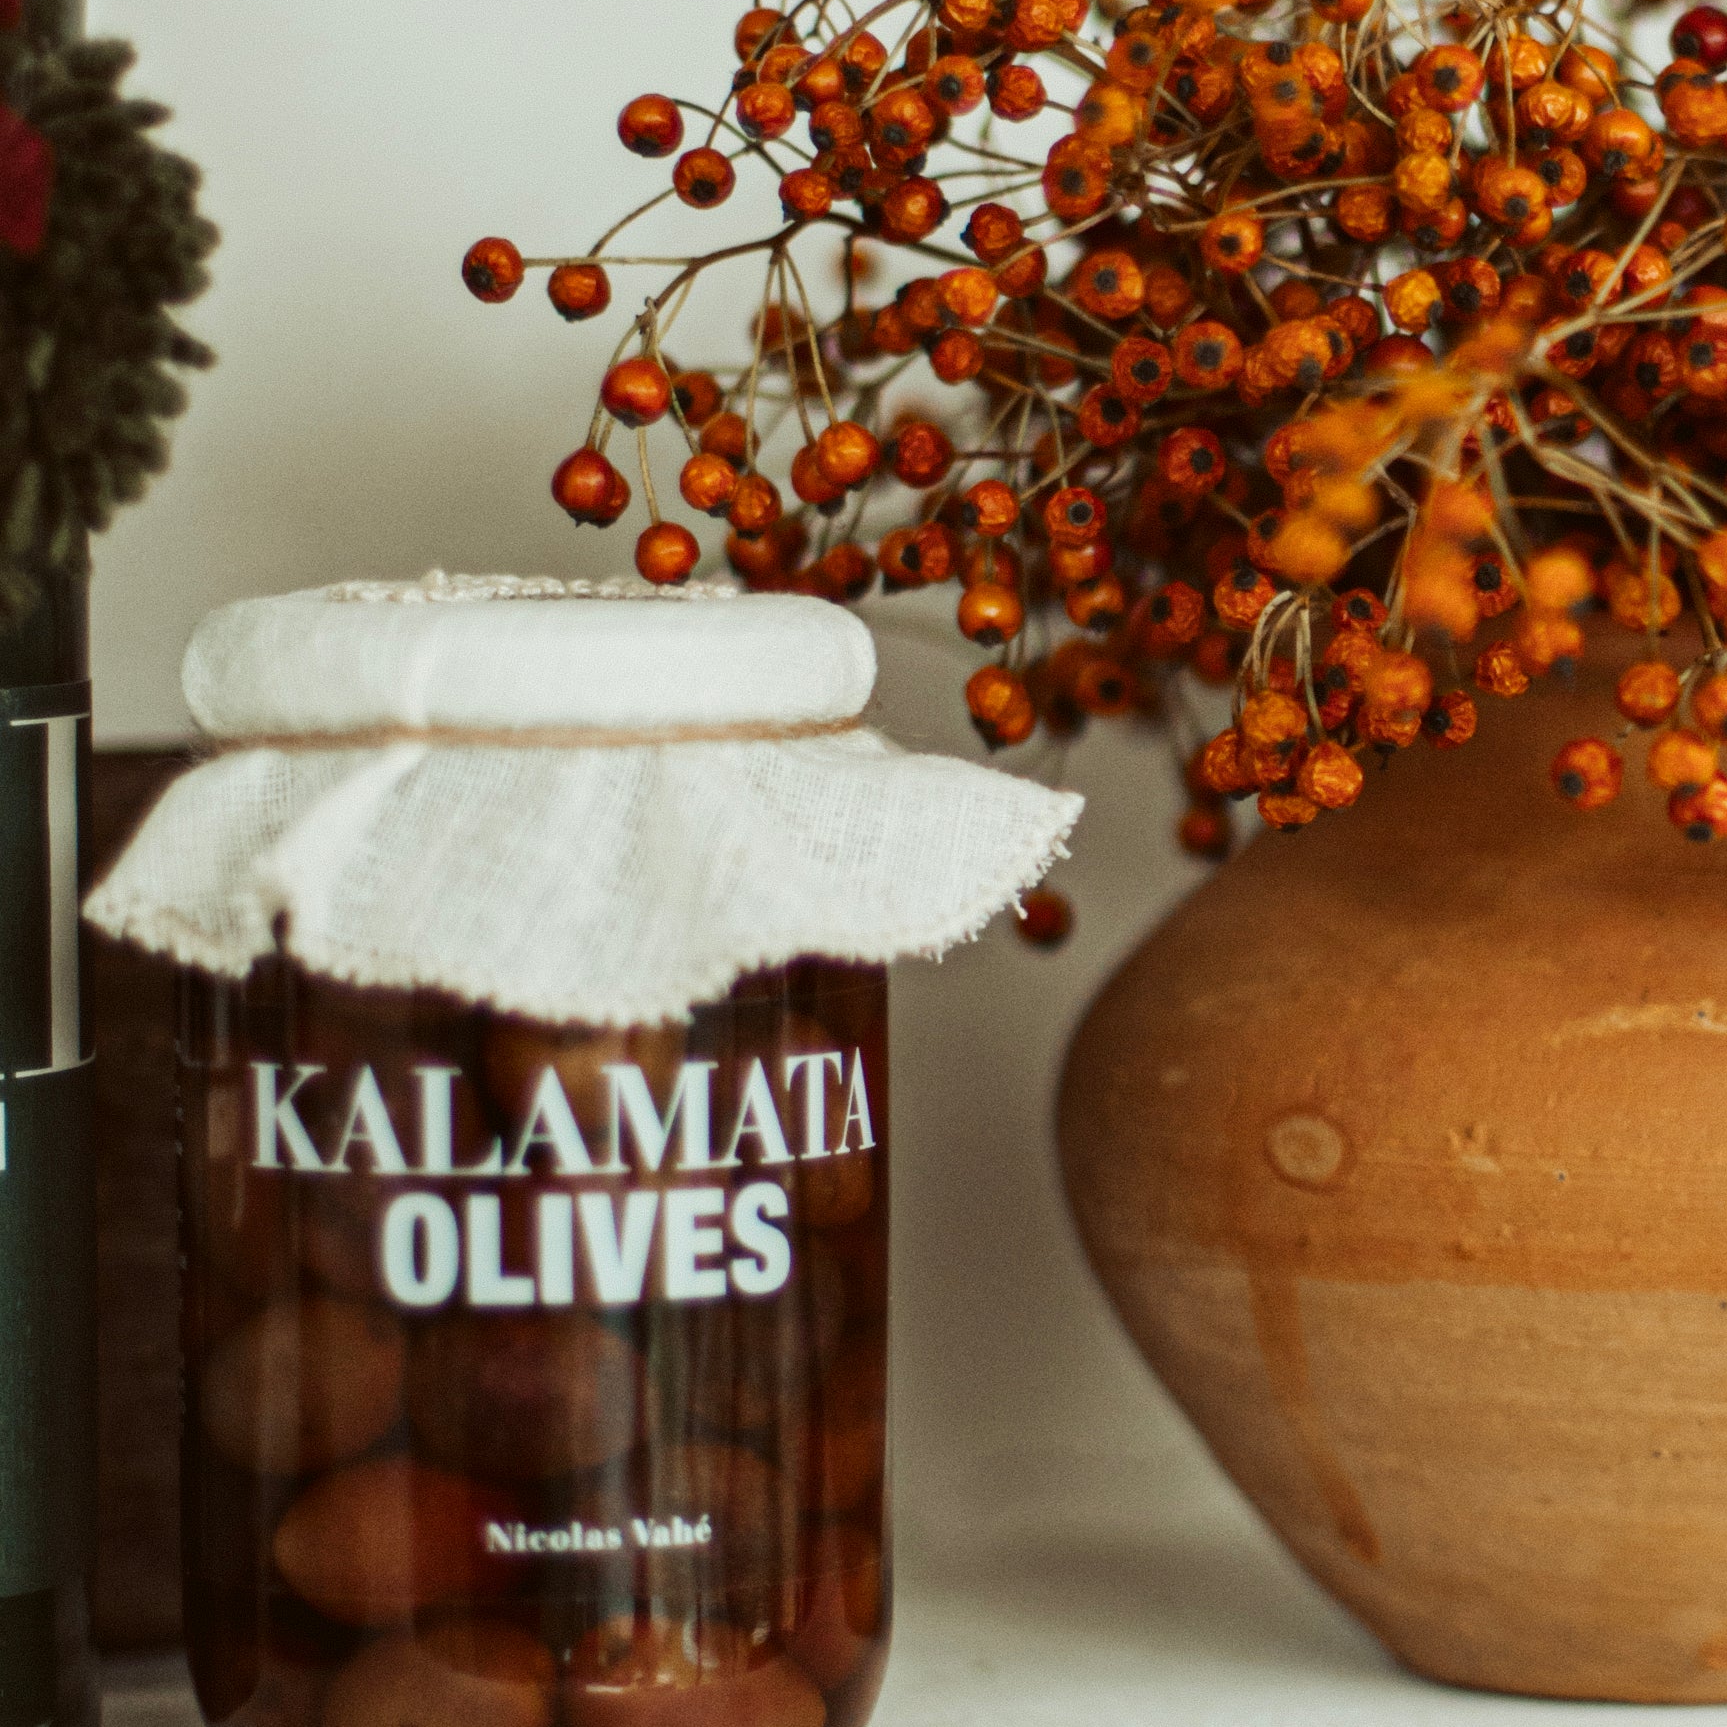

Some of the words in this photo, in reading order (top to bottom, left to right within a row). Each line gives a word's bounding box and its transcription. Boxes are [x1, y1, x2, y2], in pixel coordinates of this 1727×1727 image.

[250, 1046, 876, 1176] KALAMATA
[381, 1181, 793, 1309] OLIVES
[485, 1520, 623, 1553] Nicolas
[631, 1513, 712, 1548] Vahé
